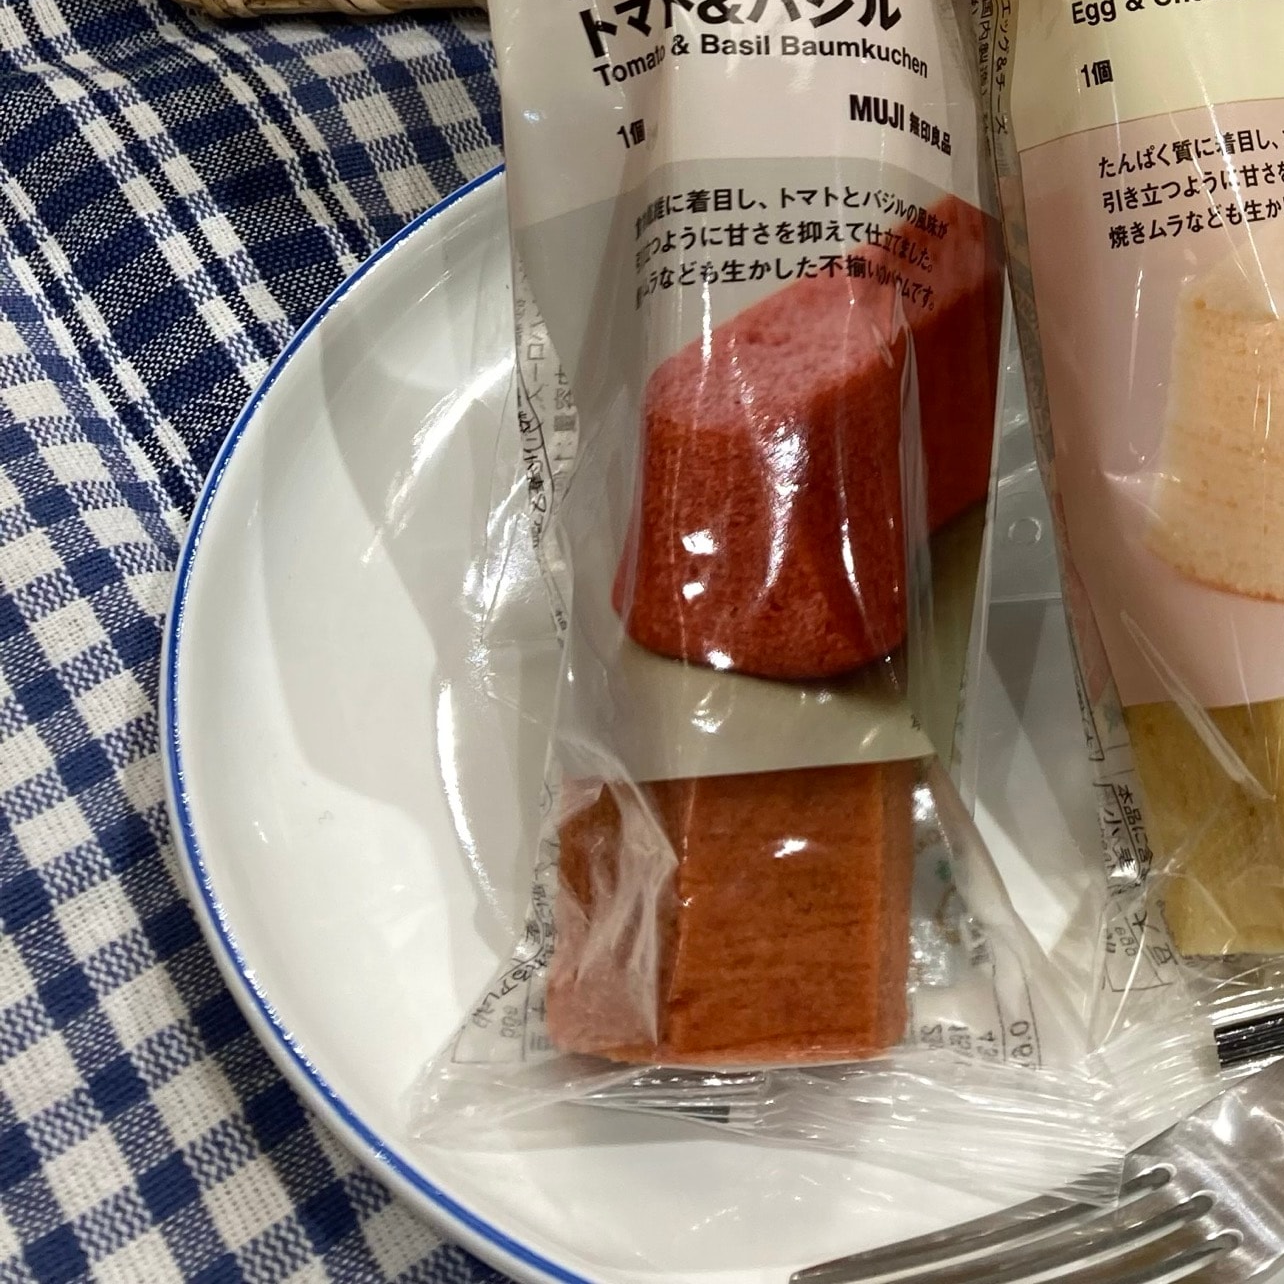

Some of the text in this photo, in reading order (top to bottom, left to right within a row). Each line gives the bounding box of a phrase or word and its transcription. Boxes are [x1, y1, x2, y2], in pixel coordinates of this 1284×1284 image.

[593, 33, 929, 87] Tomato & Basil Baumkuchen
[1080, 58, 1115, 89] 1個
[617, 118, 646, 149] 1個
[849, 93, 905, 131] MUJI
[909, 111, 953, 156] 無印良品
